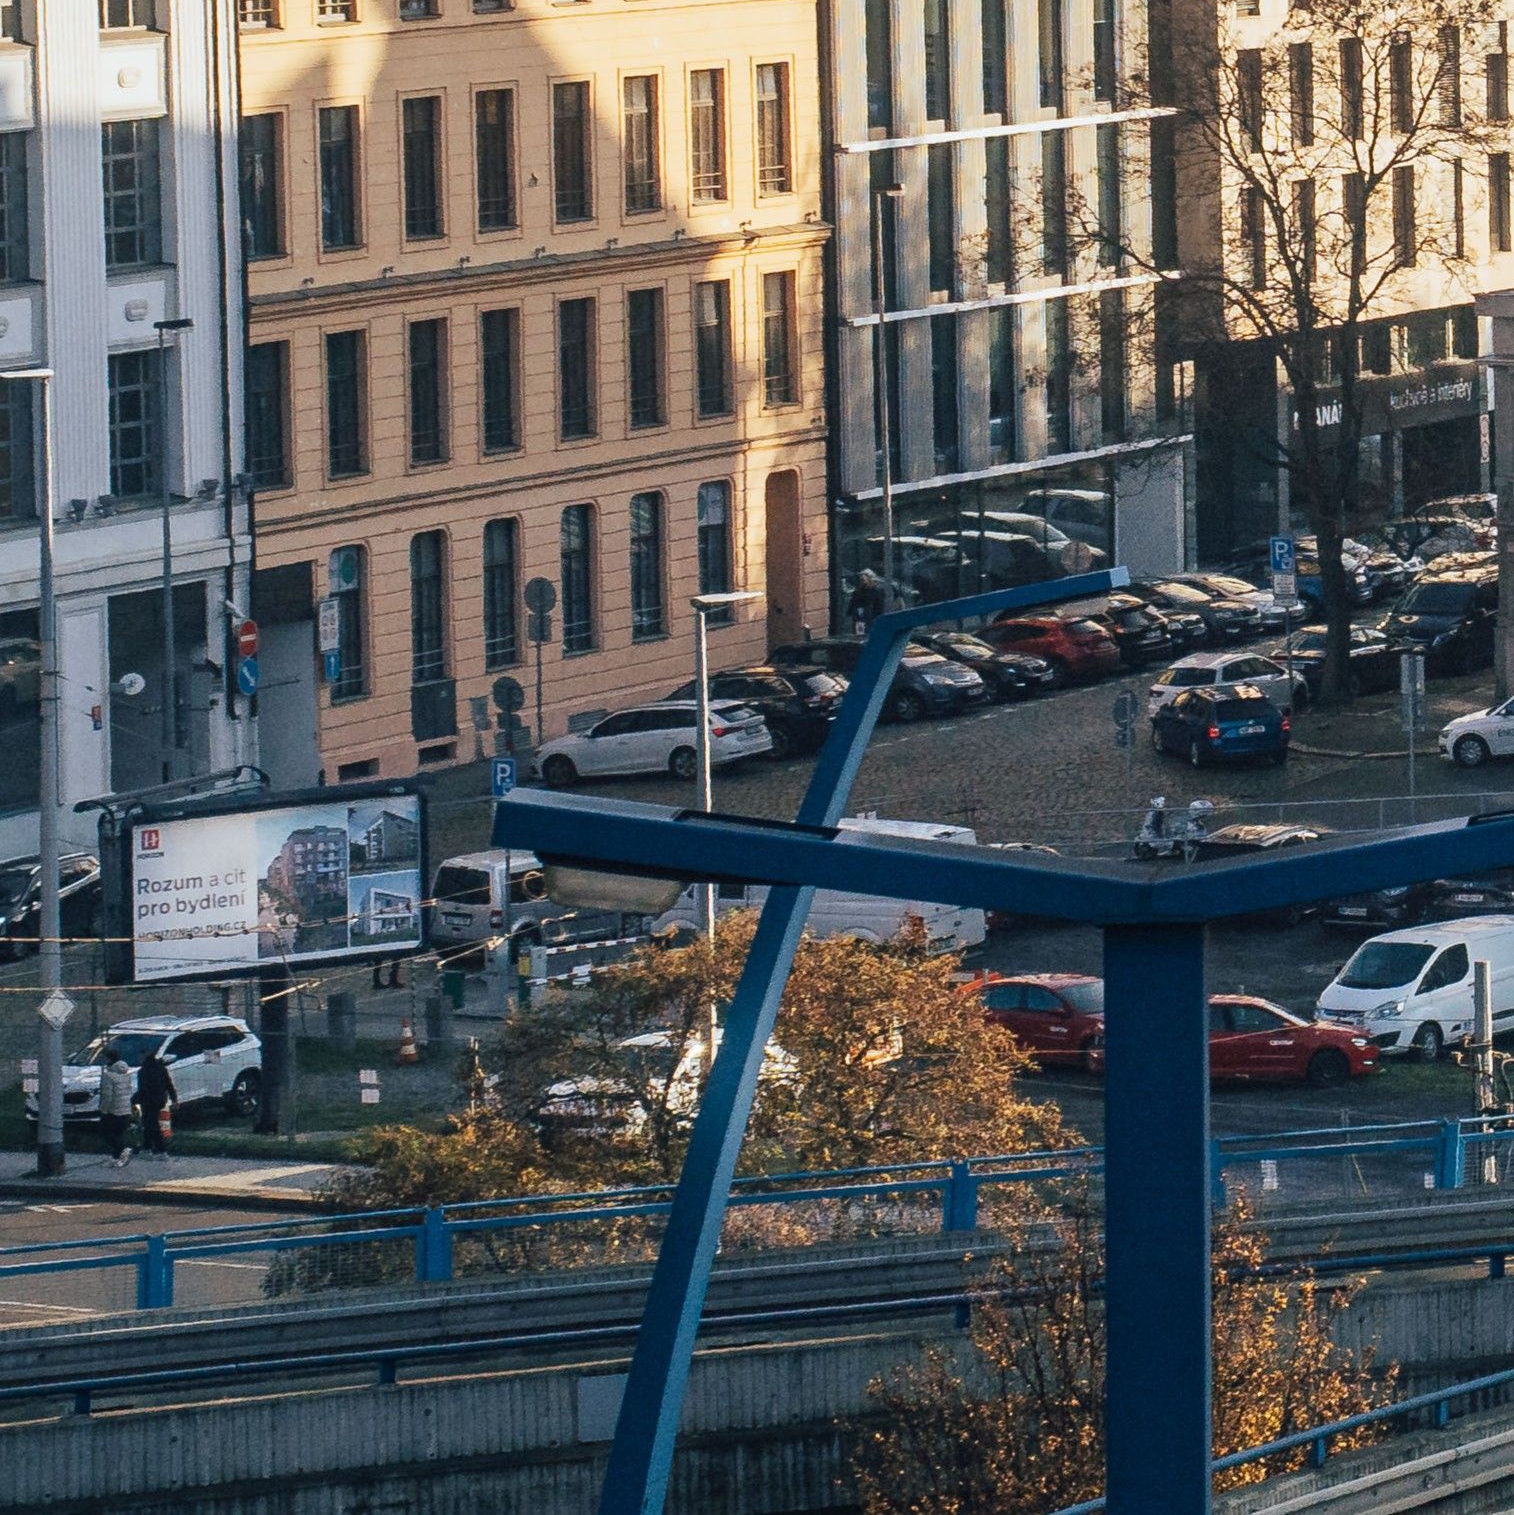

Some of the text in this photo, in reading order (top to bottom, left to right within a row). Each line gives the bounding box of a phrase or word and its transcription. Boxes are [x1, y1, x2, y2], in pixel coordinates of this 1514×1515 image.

[137, 876, 203, 895] Rozum
[209, 874, 219, 887] a
[138, 890, 246, 920] pro bydlení
